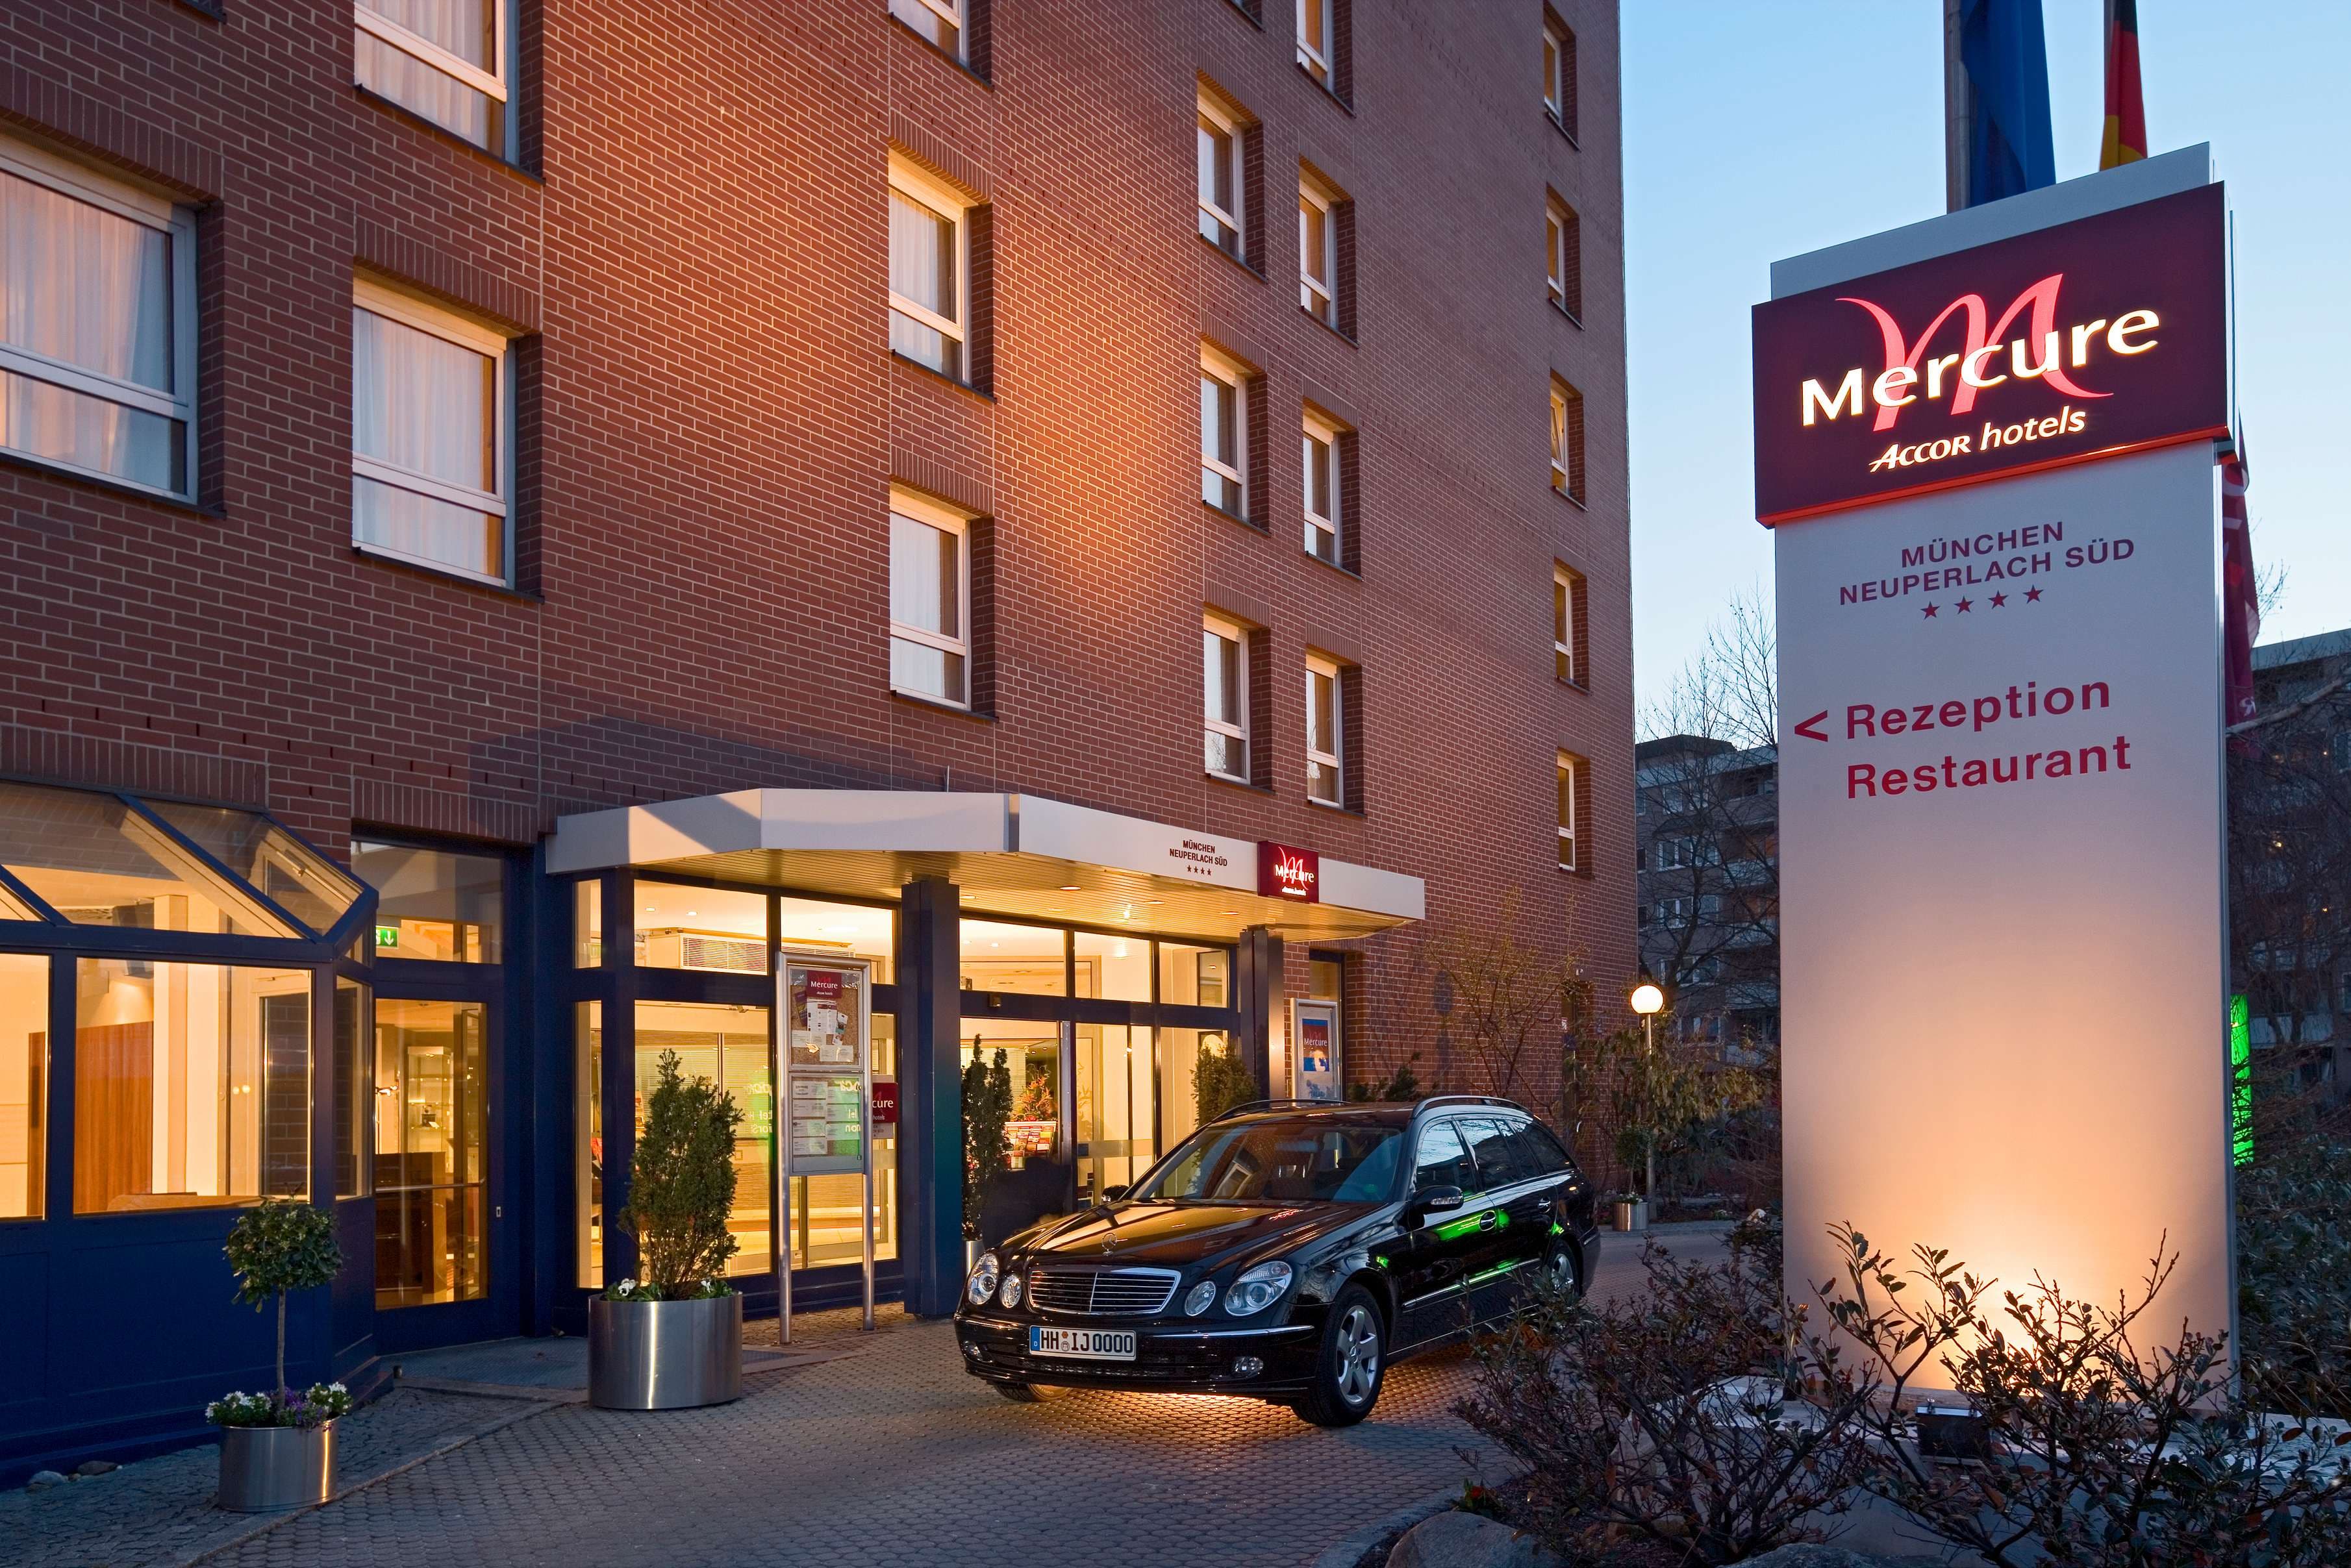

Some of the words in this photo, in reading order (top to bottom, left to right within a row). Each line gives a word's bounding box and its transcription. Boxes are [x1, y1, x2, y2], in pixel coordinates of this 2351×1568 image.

[1802, 308, 2161, 427] Mercure
[1980, 406, 2087, 452] hotels
[1901, 521, 2064, 568] MÜNCHEN
[1839, 554, 2052, 606] NEUPERLACH
[2065, 538, 2135, 569] SÜD
[1846, 681, 2110, 740] Rezeption
[1847, 736, 2131, 799] Restaurant
[1182, 840, 1216, 854] MÜNCHEN
[1169, 848, 1213, 864] NEUPERLACH
[1214, 856, 1228, 867] SÜD
[1275, 864, 1315, 883] Mercure
[811, 980, 838, 989] Mercure
[1303, 1038, 1328, 1047] Mercure
[872, 1100, 894, 1108] cure
[1040, 1330, 1059, 1350] HH
